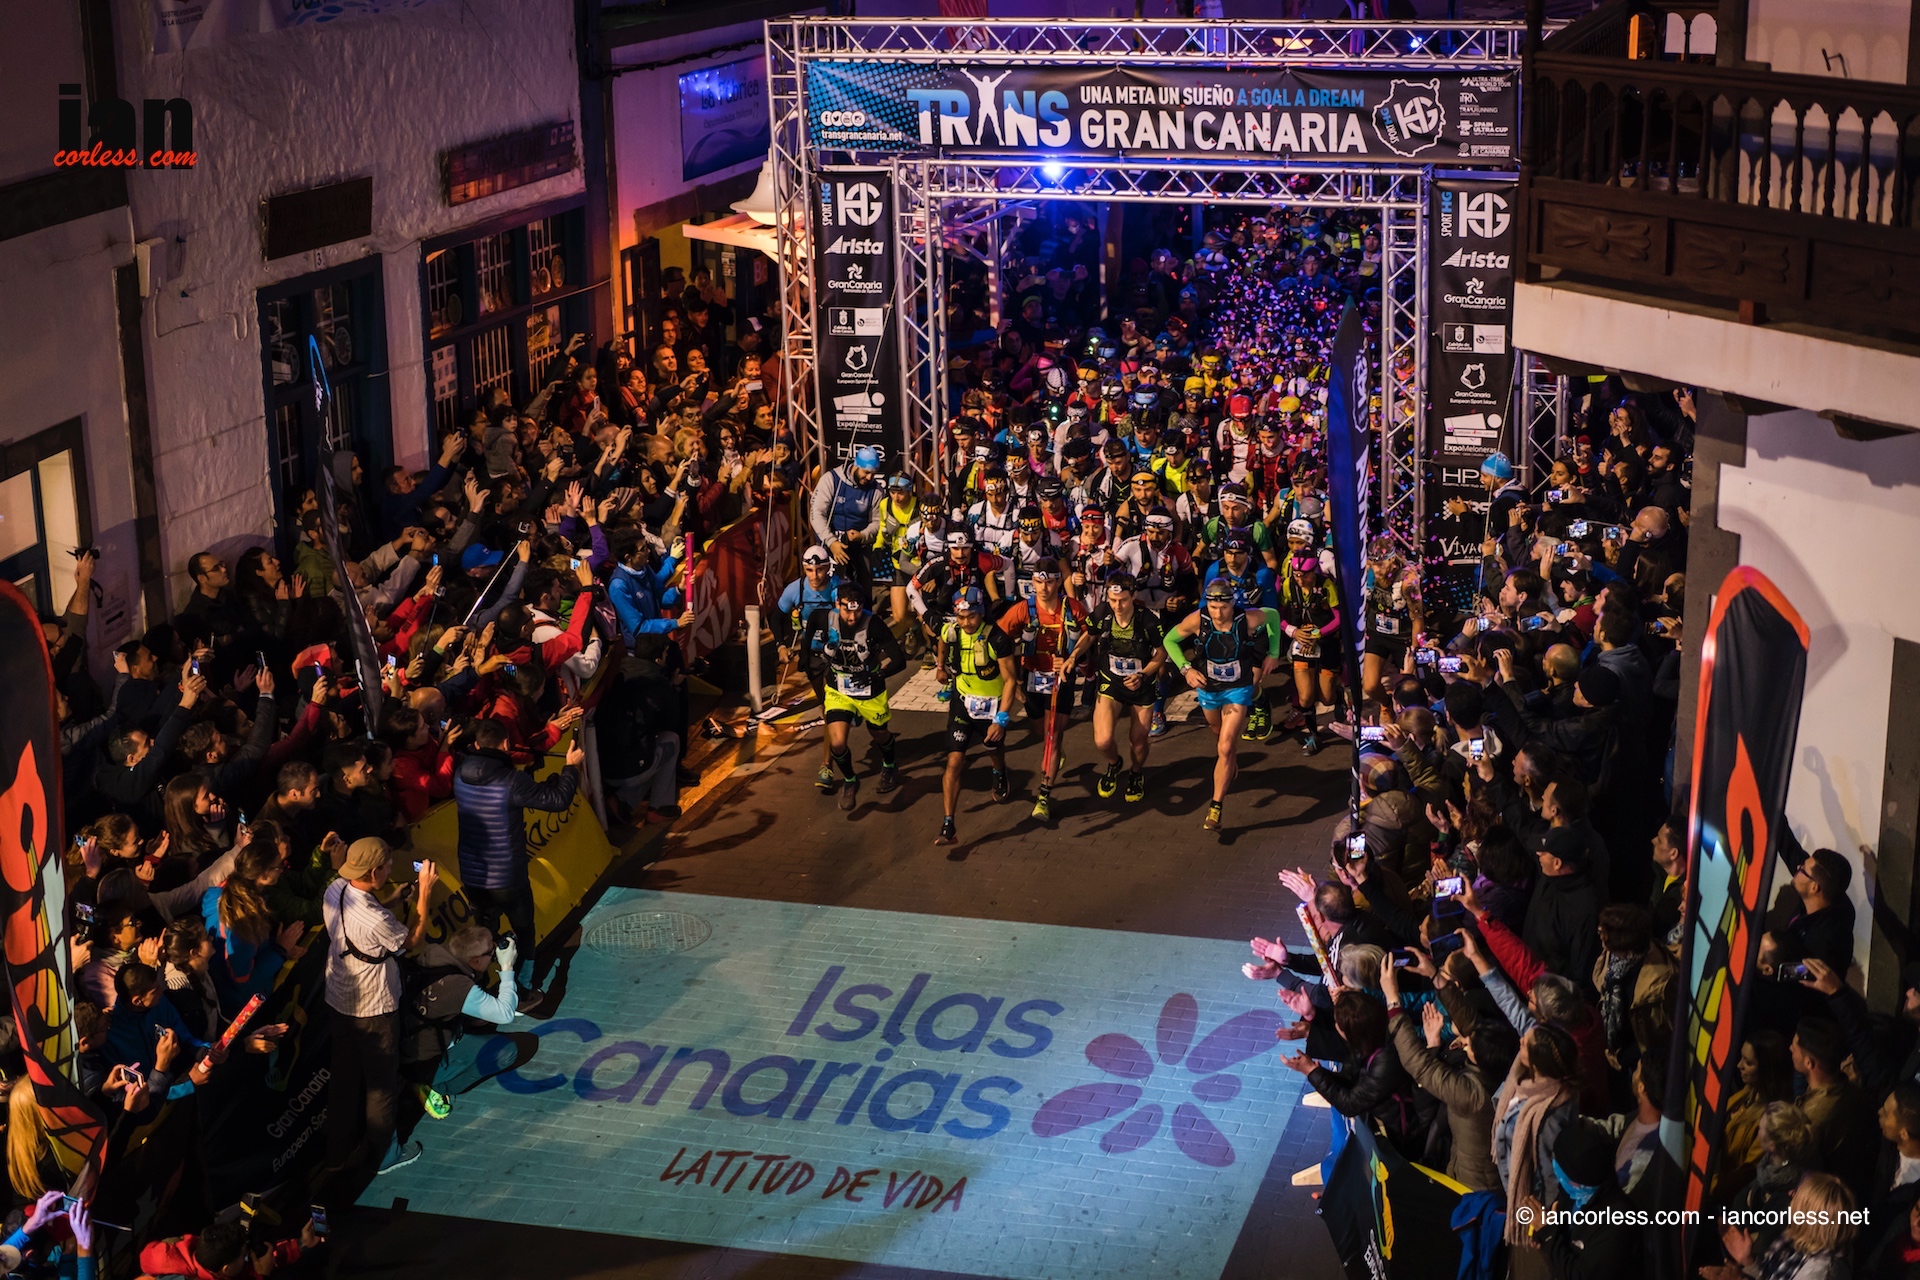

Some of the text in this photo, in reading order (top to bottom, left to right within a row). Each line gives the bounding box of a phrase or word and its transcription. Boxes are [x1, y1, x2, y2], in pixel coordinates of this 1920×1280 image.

[1080, 84, 1365, 108] UNA META UN SUEÑO A GOAL A DREAM
[821, 129, 902, 142] transgrancanaria.net
[1080, 109, 1368, 154] GRAN CANARIA
[824, 234, 884, 255] Arista
[1441, 247, 1511, 269] Arista
[785, 965, 1065, 1059] Islas
[475, 1018, 1024, 1140] Canarias
[660, 1147, 968, 1214] LATITUD DE VIDA
